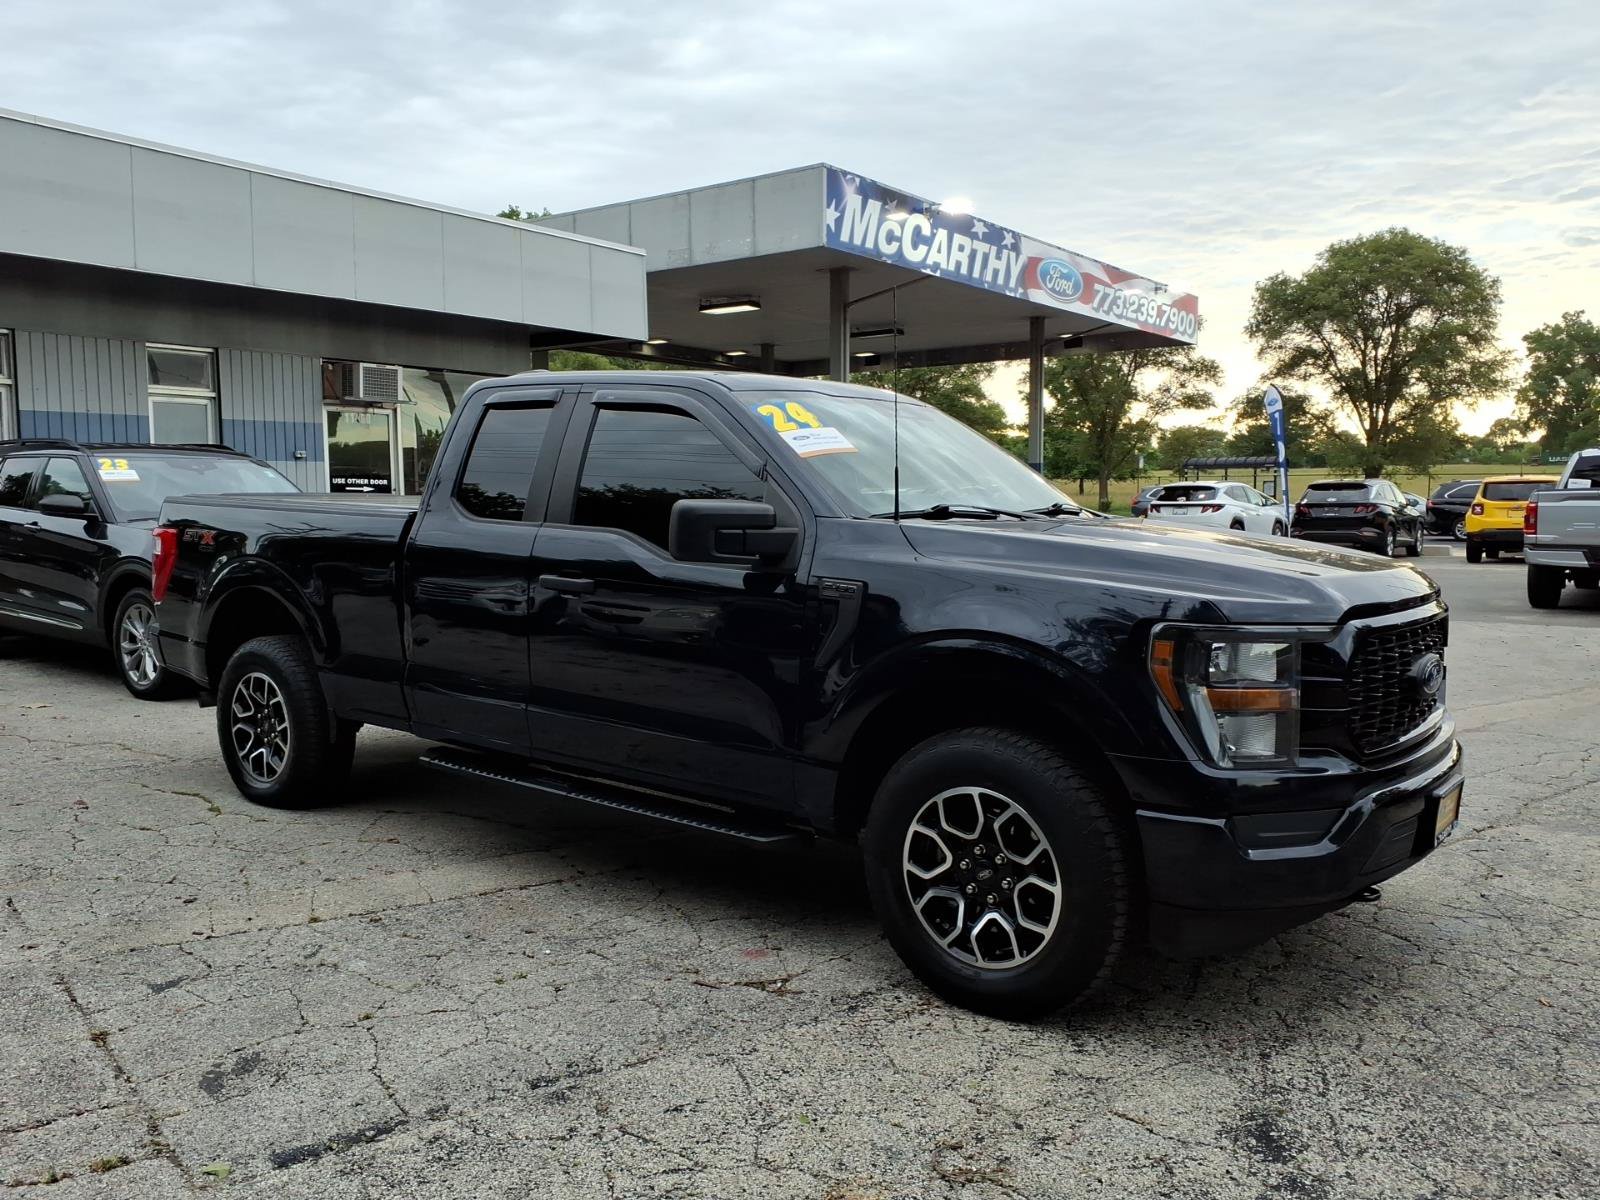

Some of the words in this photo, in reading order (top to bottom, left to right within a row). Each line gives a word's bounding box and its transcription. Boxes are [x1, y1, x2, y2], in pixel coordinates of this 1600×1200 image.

[1046, 263, 1075, 295] Ford
[1092, 283, 1196, 336] 773.239.7900
[757, 401, 822, 432] 24
